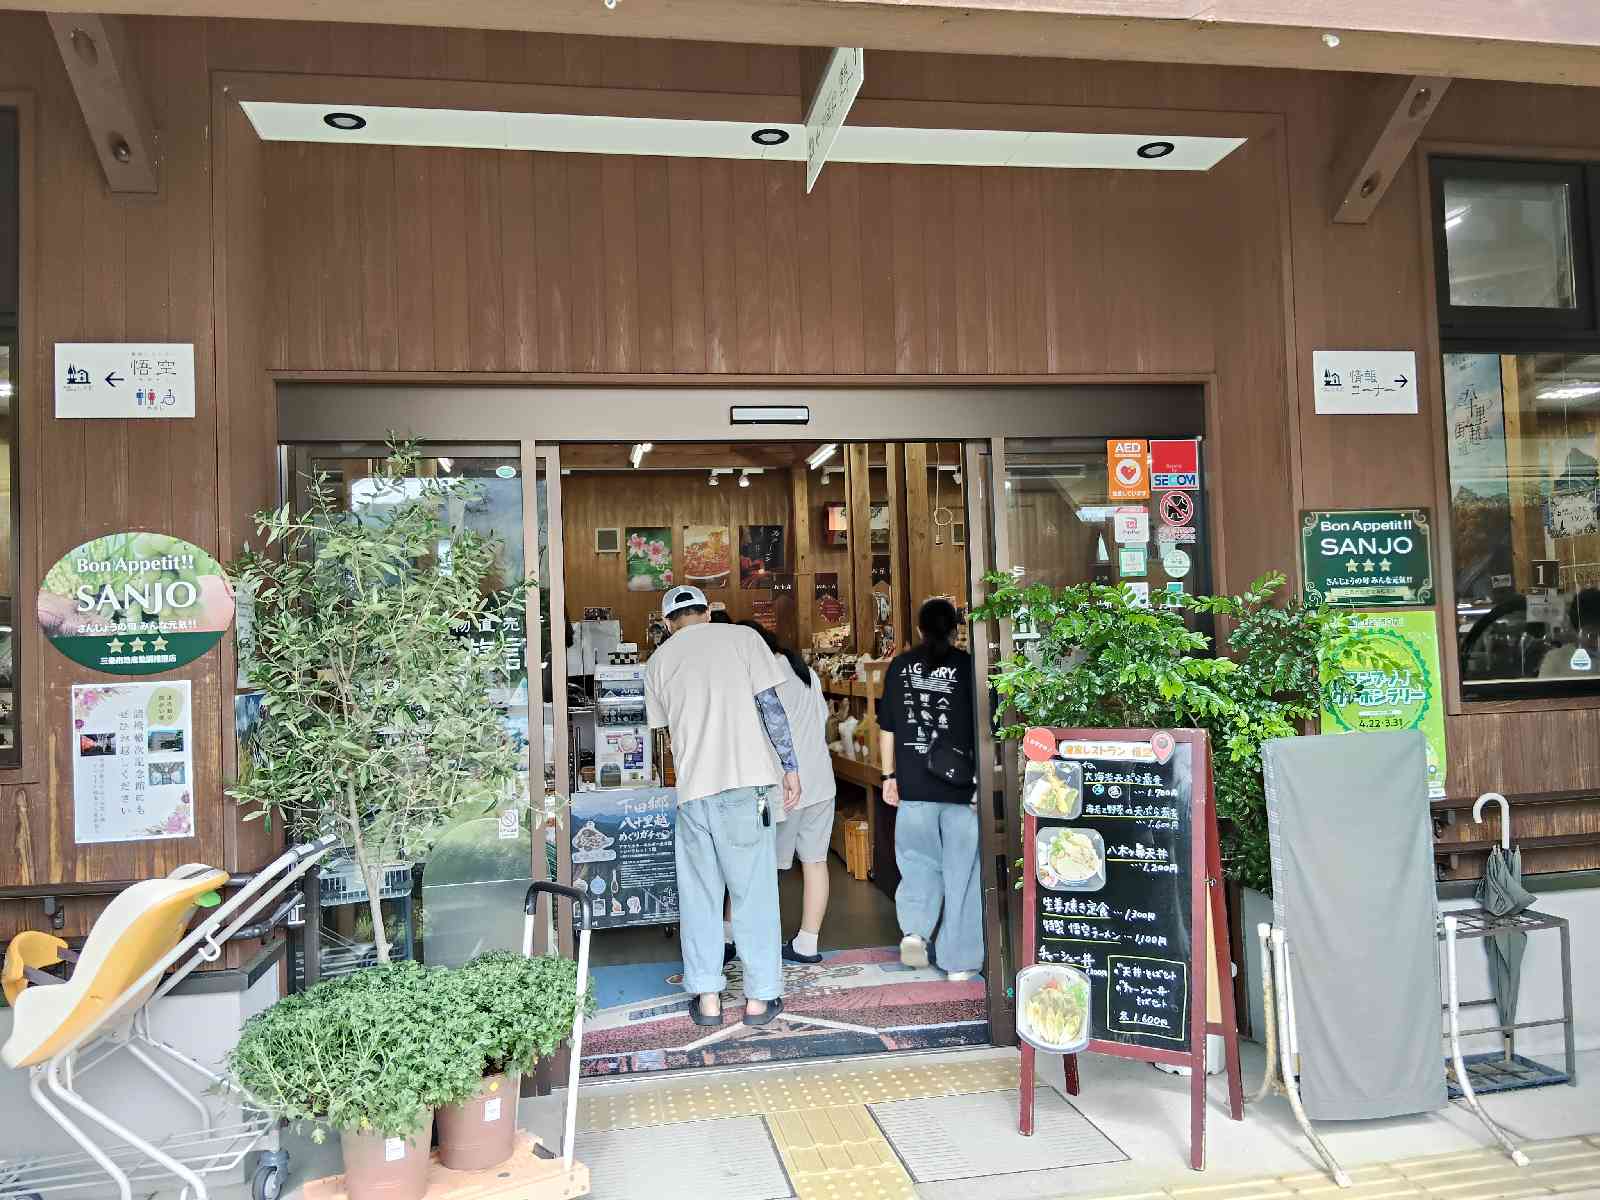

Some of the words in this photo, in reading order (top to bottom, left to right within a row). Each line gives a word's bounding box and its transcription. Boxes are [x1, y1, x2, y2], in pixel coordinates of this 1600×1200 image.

[130, 359, 177, 376] 悟空
[1348, 369, 1378, 384] 情報
[1115, 442, 1140, 453] AED
[1320, 521, 1350, 532] Bon
[1352, 520, 1412, 534] Appetit!!
[1320, 536, 1413, 556] SANJO
[77, 558, 112, 573] Bon
[115, 554, 194, 576] Appetit!!
[77, 581, 198, 615] SANJO
[1042, 896, 1110, 917] 生姜焼き定食
